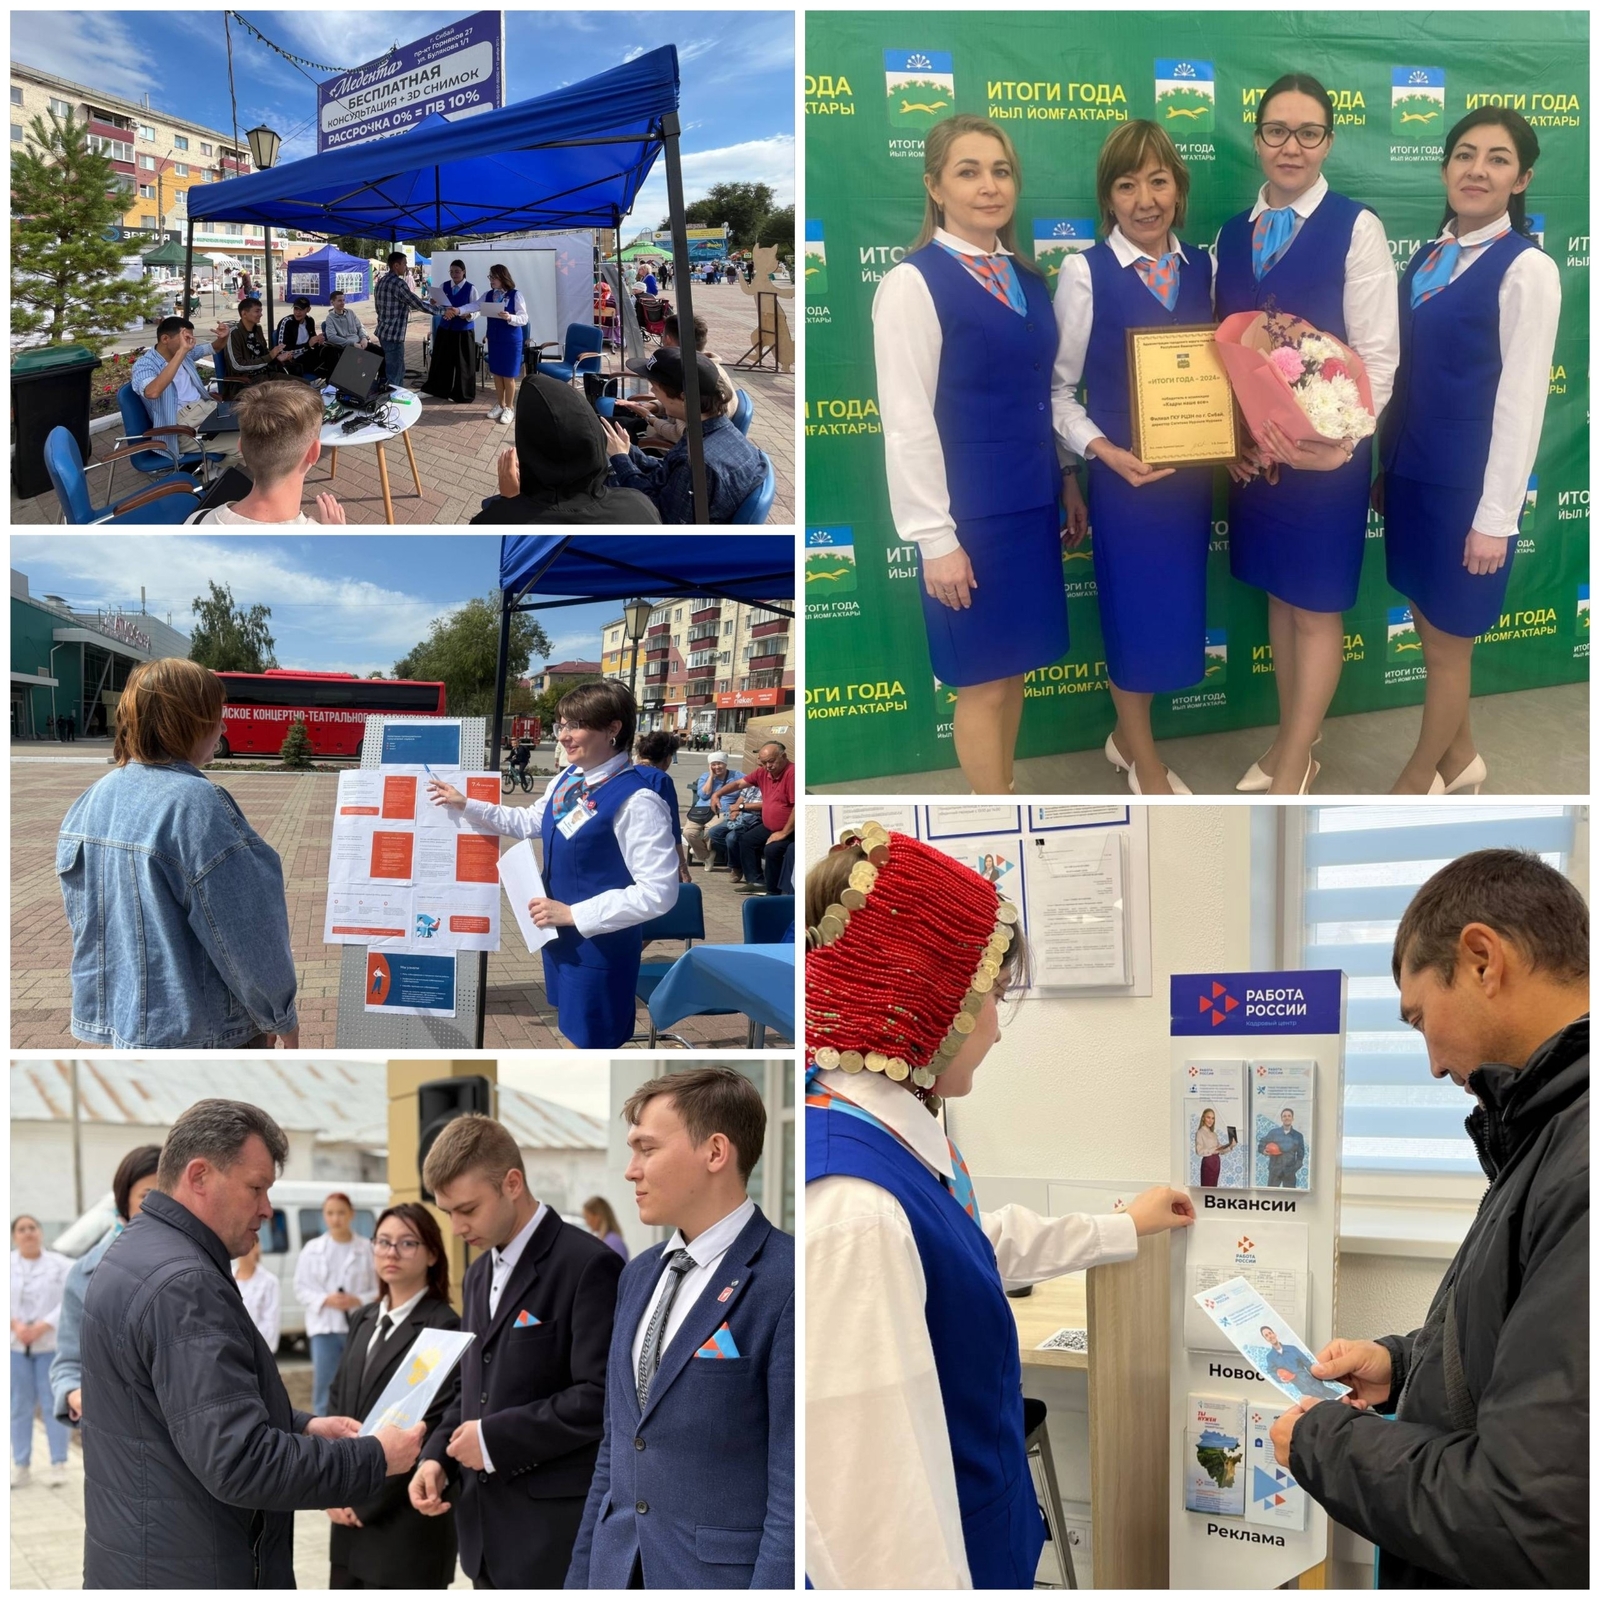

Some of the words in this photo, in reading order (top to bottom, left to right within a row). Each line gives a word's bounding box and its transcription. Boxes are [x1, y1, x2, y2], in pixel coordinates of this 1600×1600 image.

[435, 28, 454, 42] Сибай
[414, 45, 432, 58] пр-кт
[432, 32, 464, 50] Горняков
[464, 28, 473, 37] 27
[417, 55, 426, 64] ул.
[427, 42, 459, 60] Булякова
[349, 65, 441, 110] БЕСПЛАТНАЯ
[988, 81, 1060, 101] ИТОГИ
[1068, 83, 1126, 106] ГОДА
[328, 97, 397, 128] КОНСУЛЬТАЦИЯ
[408, 90, 420, 102] 3D
[424, 68, 479, 96] СНИМОК
[1466, 94, 1526, 110] ИТОГИ
[1532, 95, 1580, 112] ГОДА
[328, 120, 390, 145] РАССРОЧКА
[392, 110, 412, 126] 0%
[426, 100, 445, 116] ПВ
[448, 89, 480, 108] 10%
[988, 104, 1022, 118] ЙЫЛ
[888, 140, 925, 149] ИТОГИ
[1190, 144, 1215, 153] ГОДА
[1390, 146, 1418, 154] ИТОГИ
[1421, 146, 1444, 155] ГОДА
[817, 399, 879, 420] ГОДА
[1558, 509, 1582, 520] ЙЫЛ
[889, 566, 918, 579] ЙЫЛ
[832, 601, 859, 610] ГОДА
[1515, 608, 1556, 626] ГОДА
[1024, 663, 1088, 683] ИТОГИ
[1385, 669, 1410, 678] ИТОГИ
[847, 681, 905, 700] ГОДА
[1024, 686, 1054, 698] ЙЫЛ
[1172, 695, 1201, 704] ИТОГИ
[1203, 692, 1226, 701] ГОДА
[253, 708, 368, 723] КОНЦЕРТНО-ТЕАТРАЛЬНОЕ
[1246, 988, 1304, 1002] РАБОТА
[1246, 1004, 1306, 1017] РОССИИ
[1204, 1195, 1296, 1212] Вакансии
[1207, 1523, 1285, 1546] Реклама
